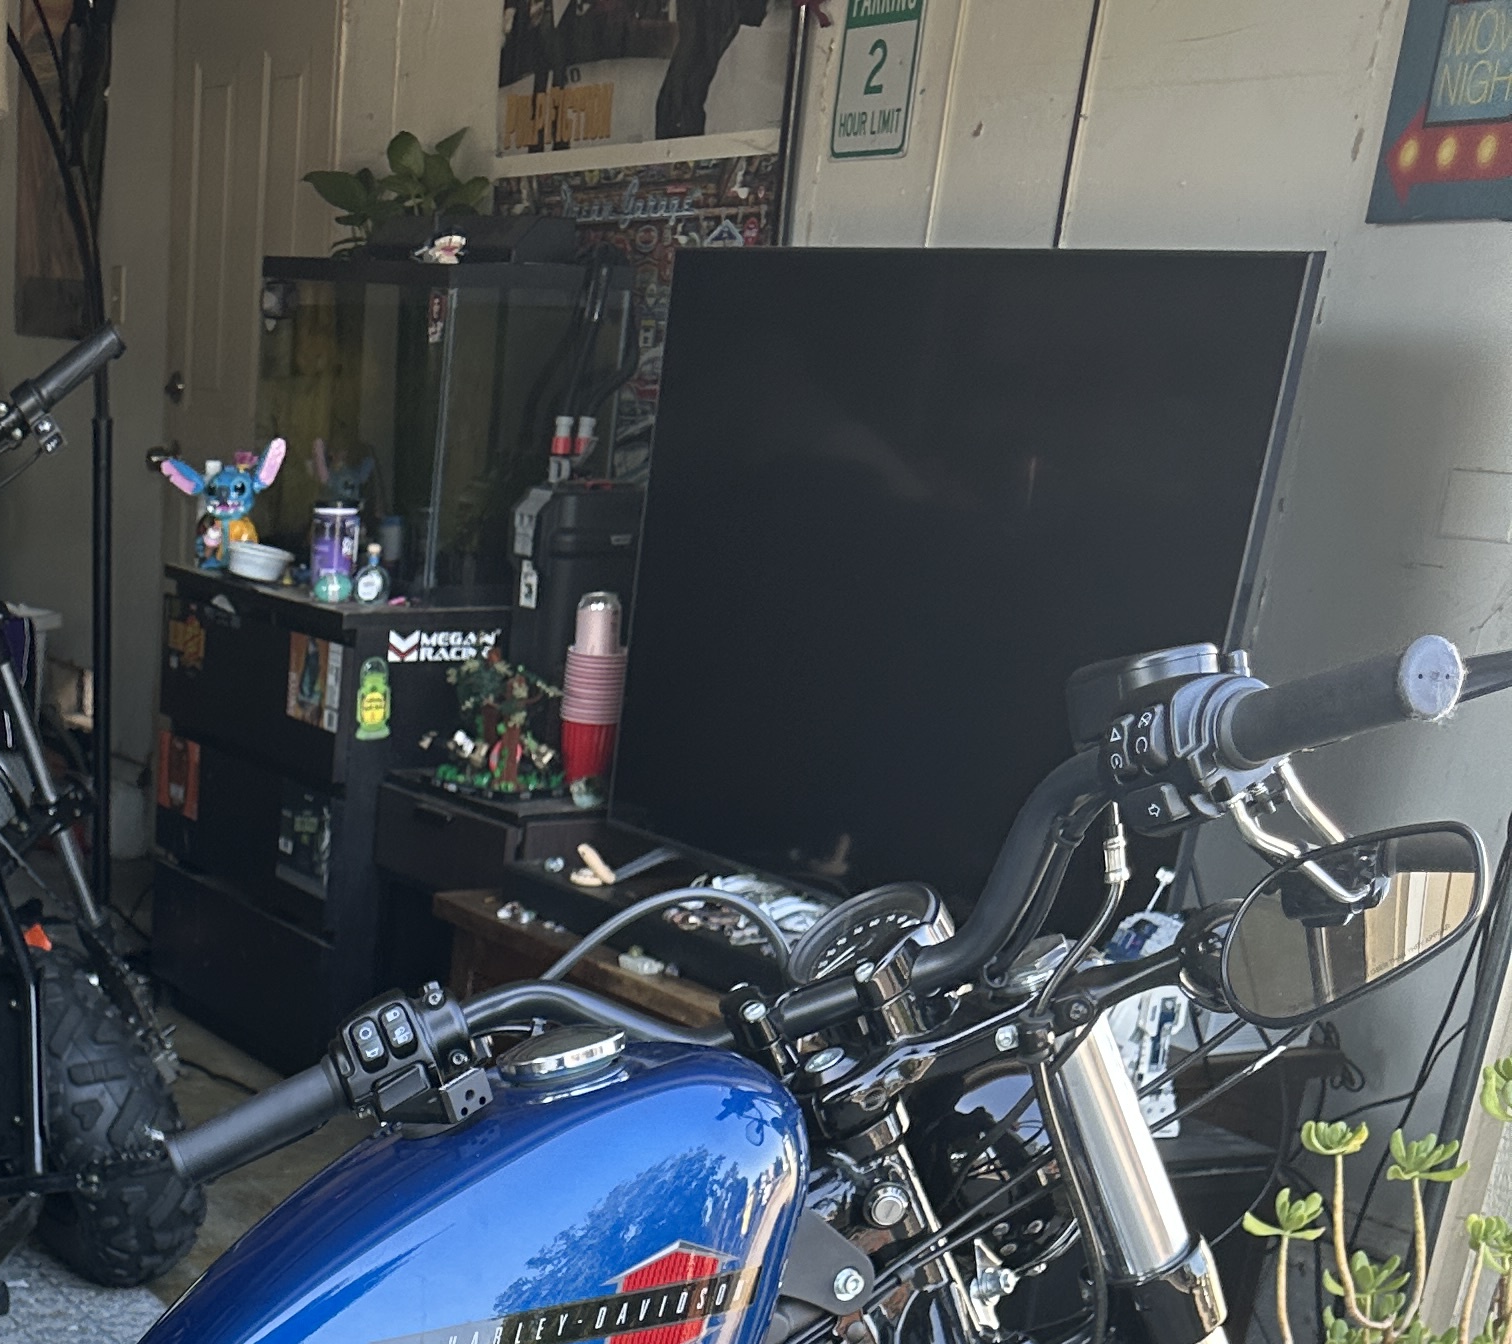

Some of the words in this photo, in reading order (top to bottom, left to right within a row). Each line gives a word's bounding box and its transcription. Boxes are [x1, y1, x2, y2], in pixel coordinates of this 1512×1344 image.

[863, 38, 888, 95] 2
[504, 91, 548, 150] PULP
[545, 82, 614, 145] FICTION
[838, 111, 868, 138] HOUR
[870, 108, 902, 135] LIMIT
[420, 631, 497, 647] MEGAN
